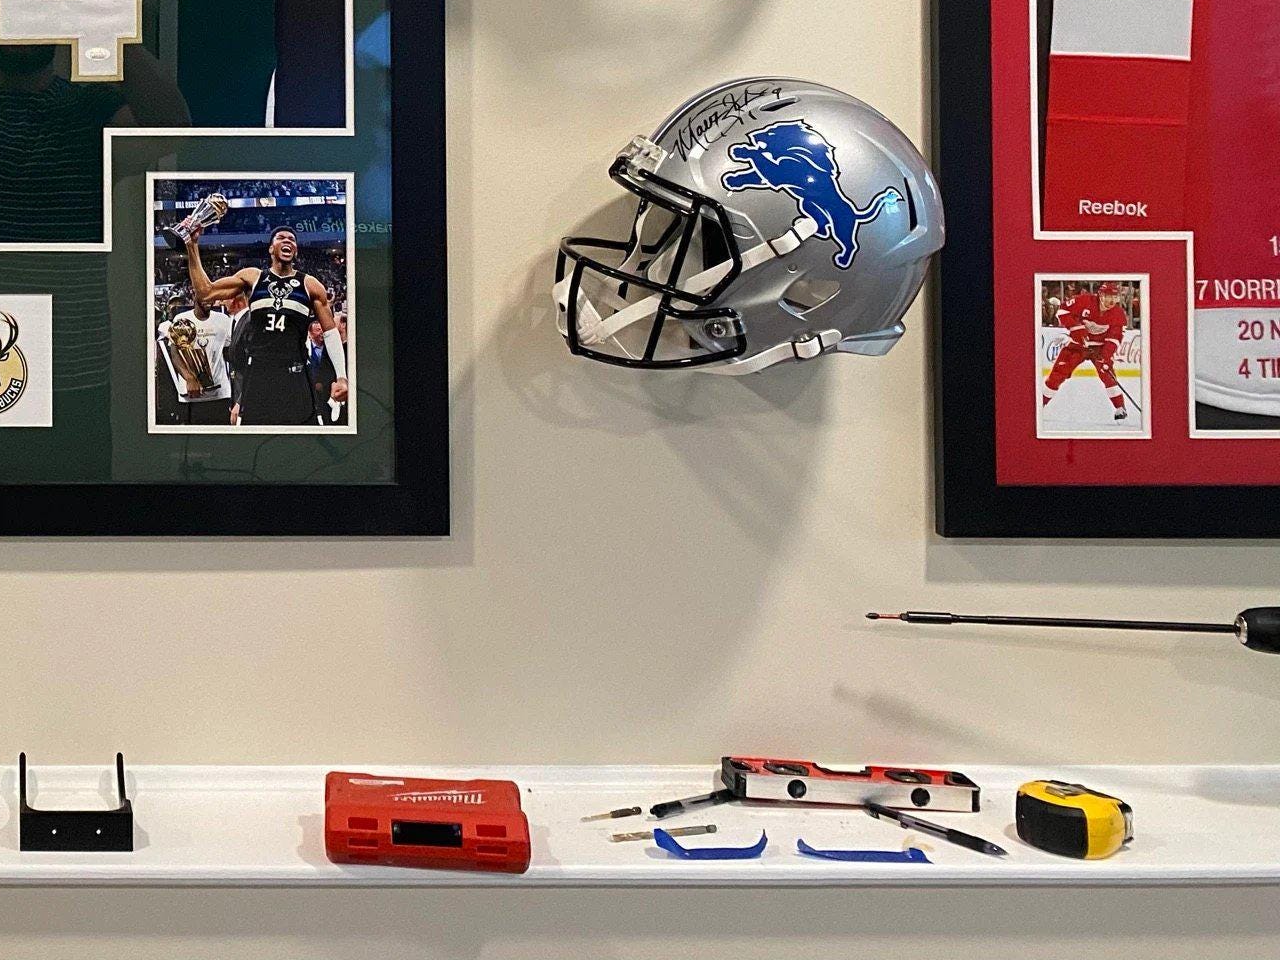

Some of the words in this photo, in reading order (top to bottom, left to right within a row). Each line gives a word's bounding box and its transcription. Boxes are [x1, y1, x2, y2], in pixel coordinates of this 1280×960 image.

[1078, 199, 1149, 218] Reebok
[1196, 279, 1209, 301] 7
[265, 313, 286, 332] 34
[1237, 320, 1265, 341] 20
[1238, 358, 1252, 380] 4
